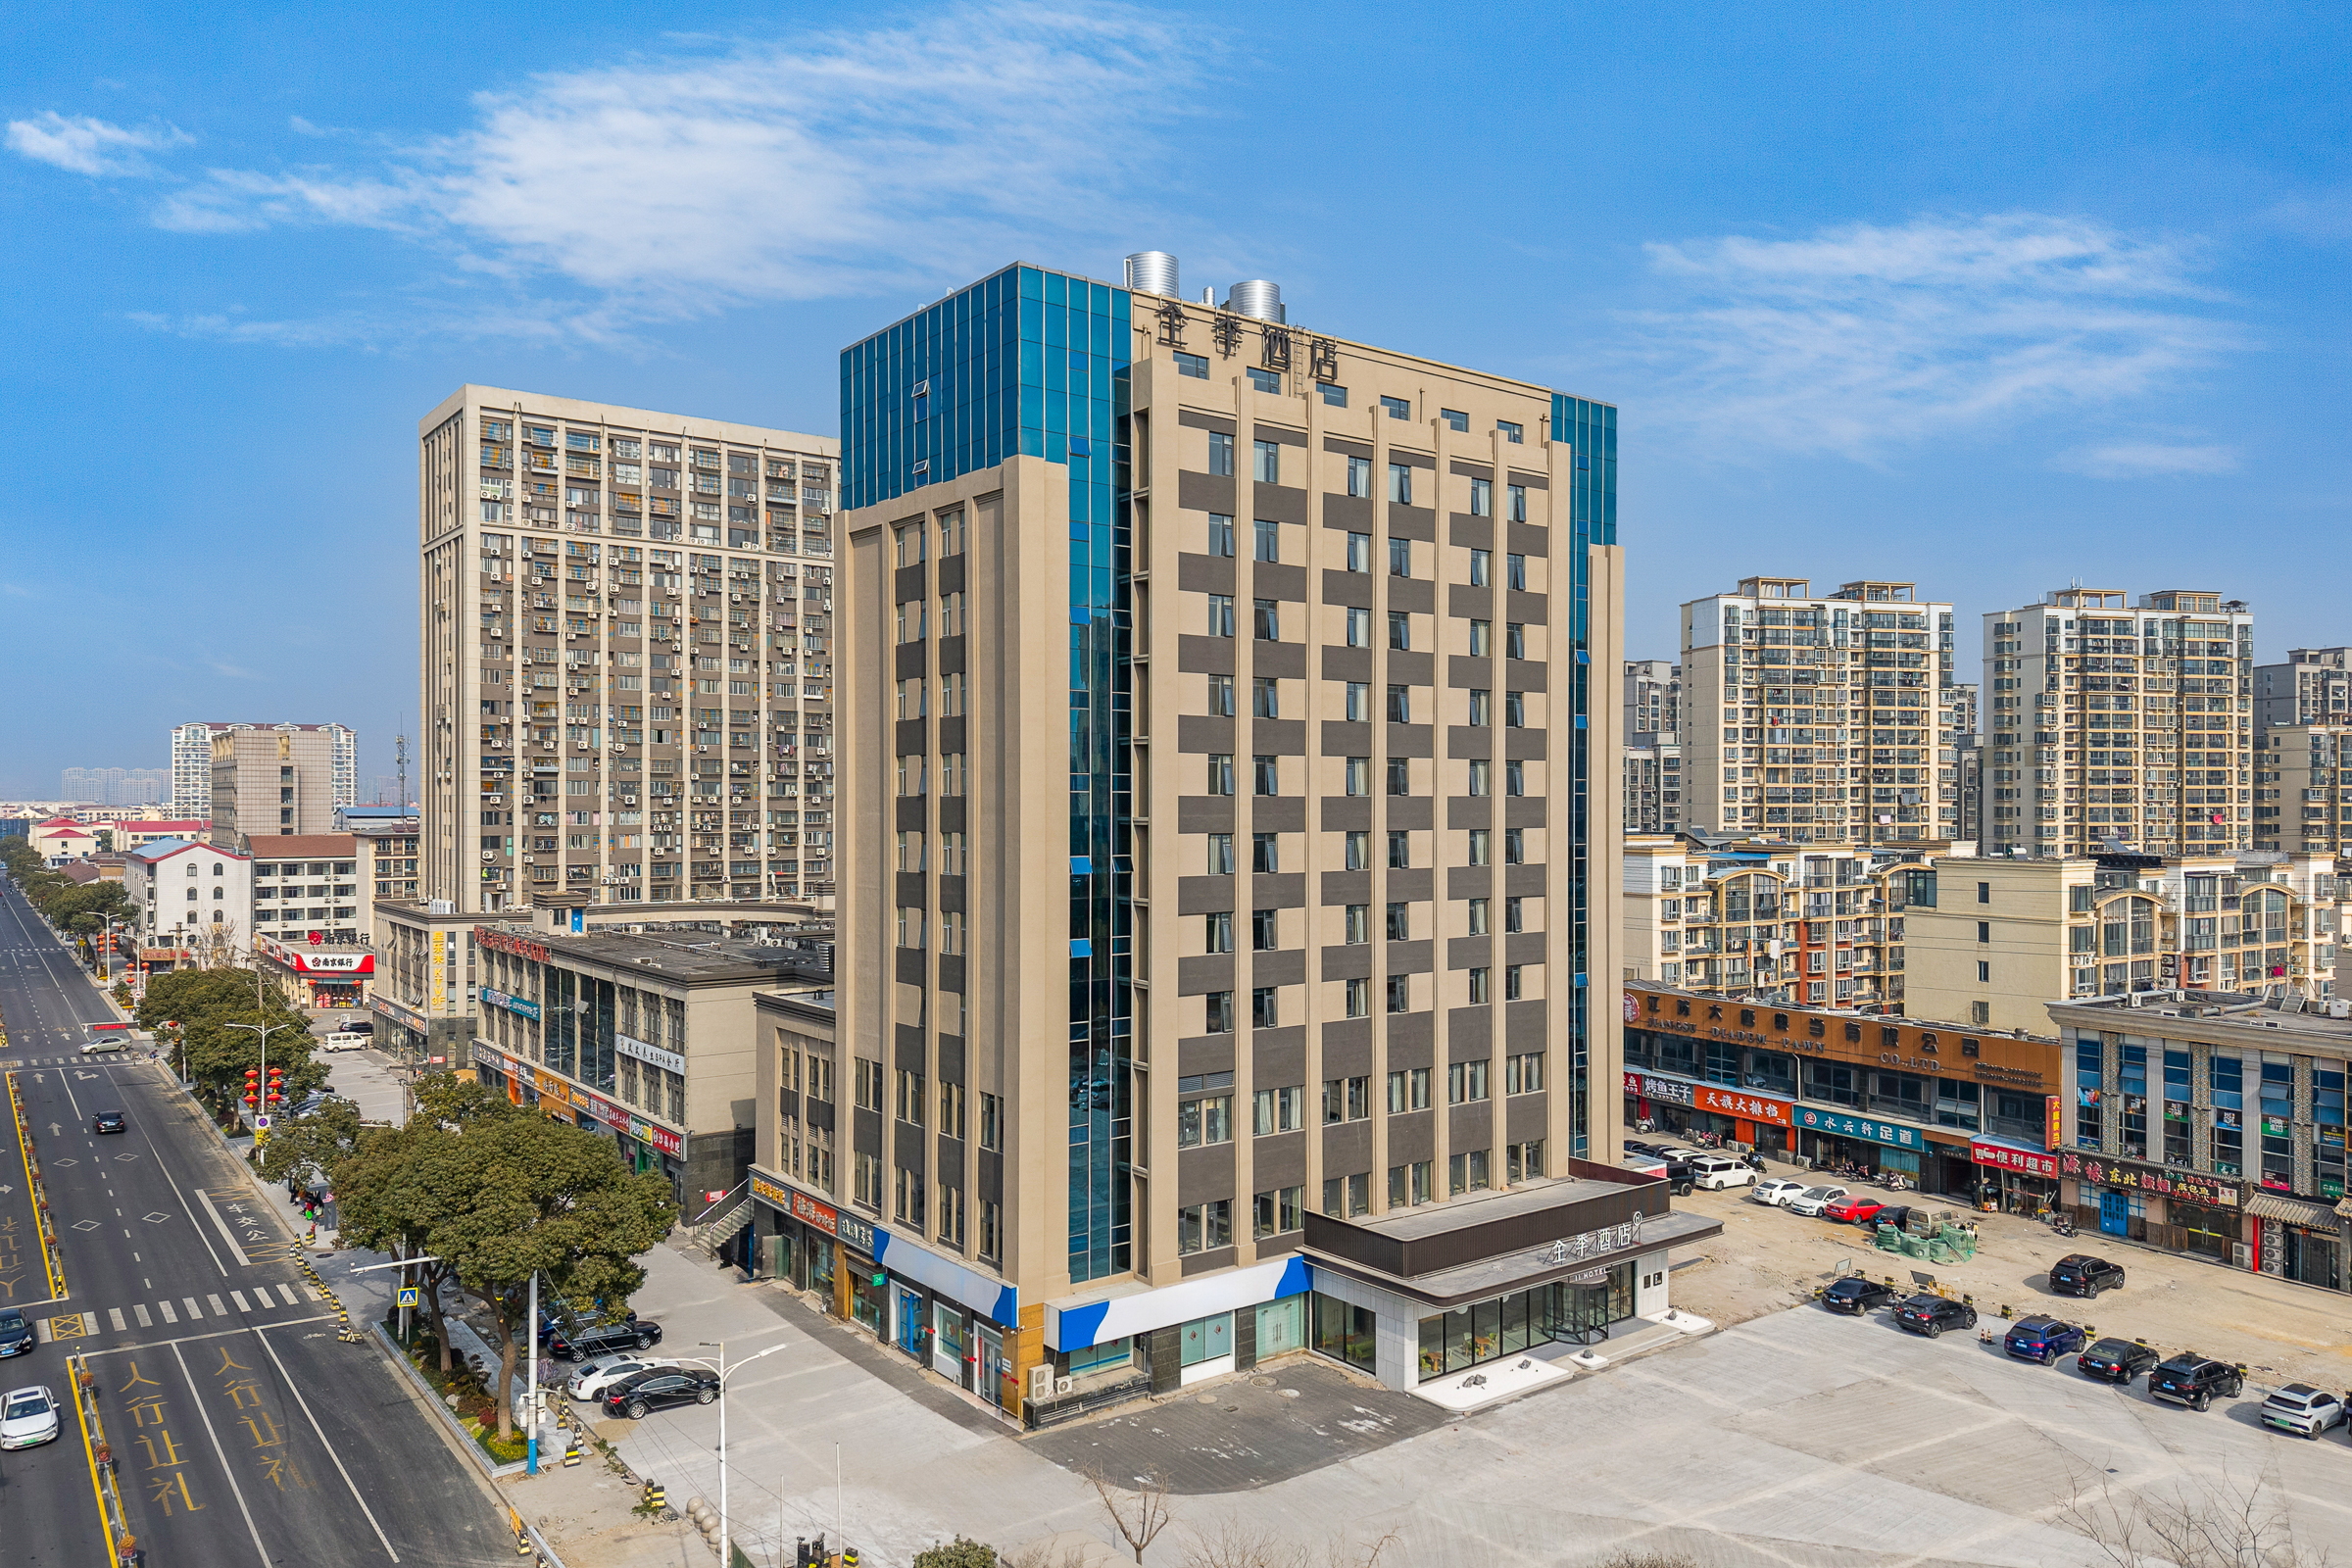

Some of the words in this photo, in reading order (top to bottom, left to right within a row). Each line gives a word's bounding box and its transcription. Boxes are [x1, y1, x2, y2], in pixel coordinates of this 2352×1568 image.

[1155, 302, 1339, 380] 全季酒店
[324, 932, 370, 946] 南京银行
[322, 957, 353, 967] 南京银行
[1647, 1016, 1696, 1033] JIANGSU
[1782, 1037, 1825, 1054] PAWN
[1644, 1078, 1691, 1099] 烤鱼王子
[1824, 1116, 1912, 1145] 水云轩足道
[1995, 1150, 2054, 1173] 便利超市
[1551, 1223, 1633, 1263] 全季酒店
[1583, 1266, 1607, 1280] HOTEL
